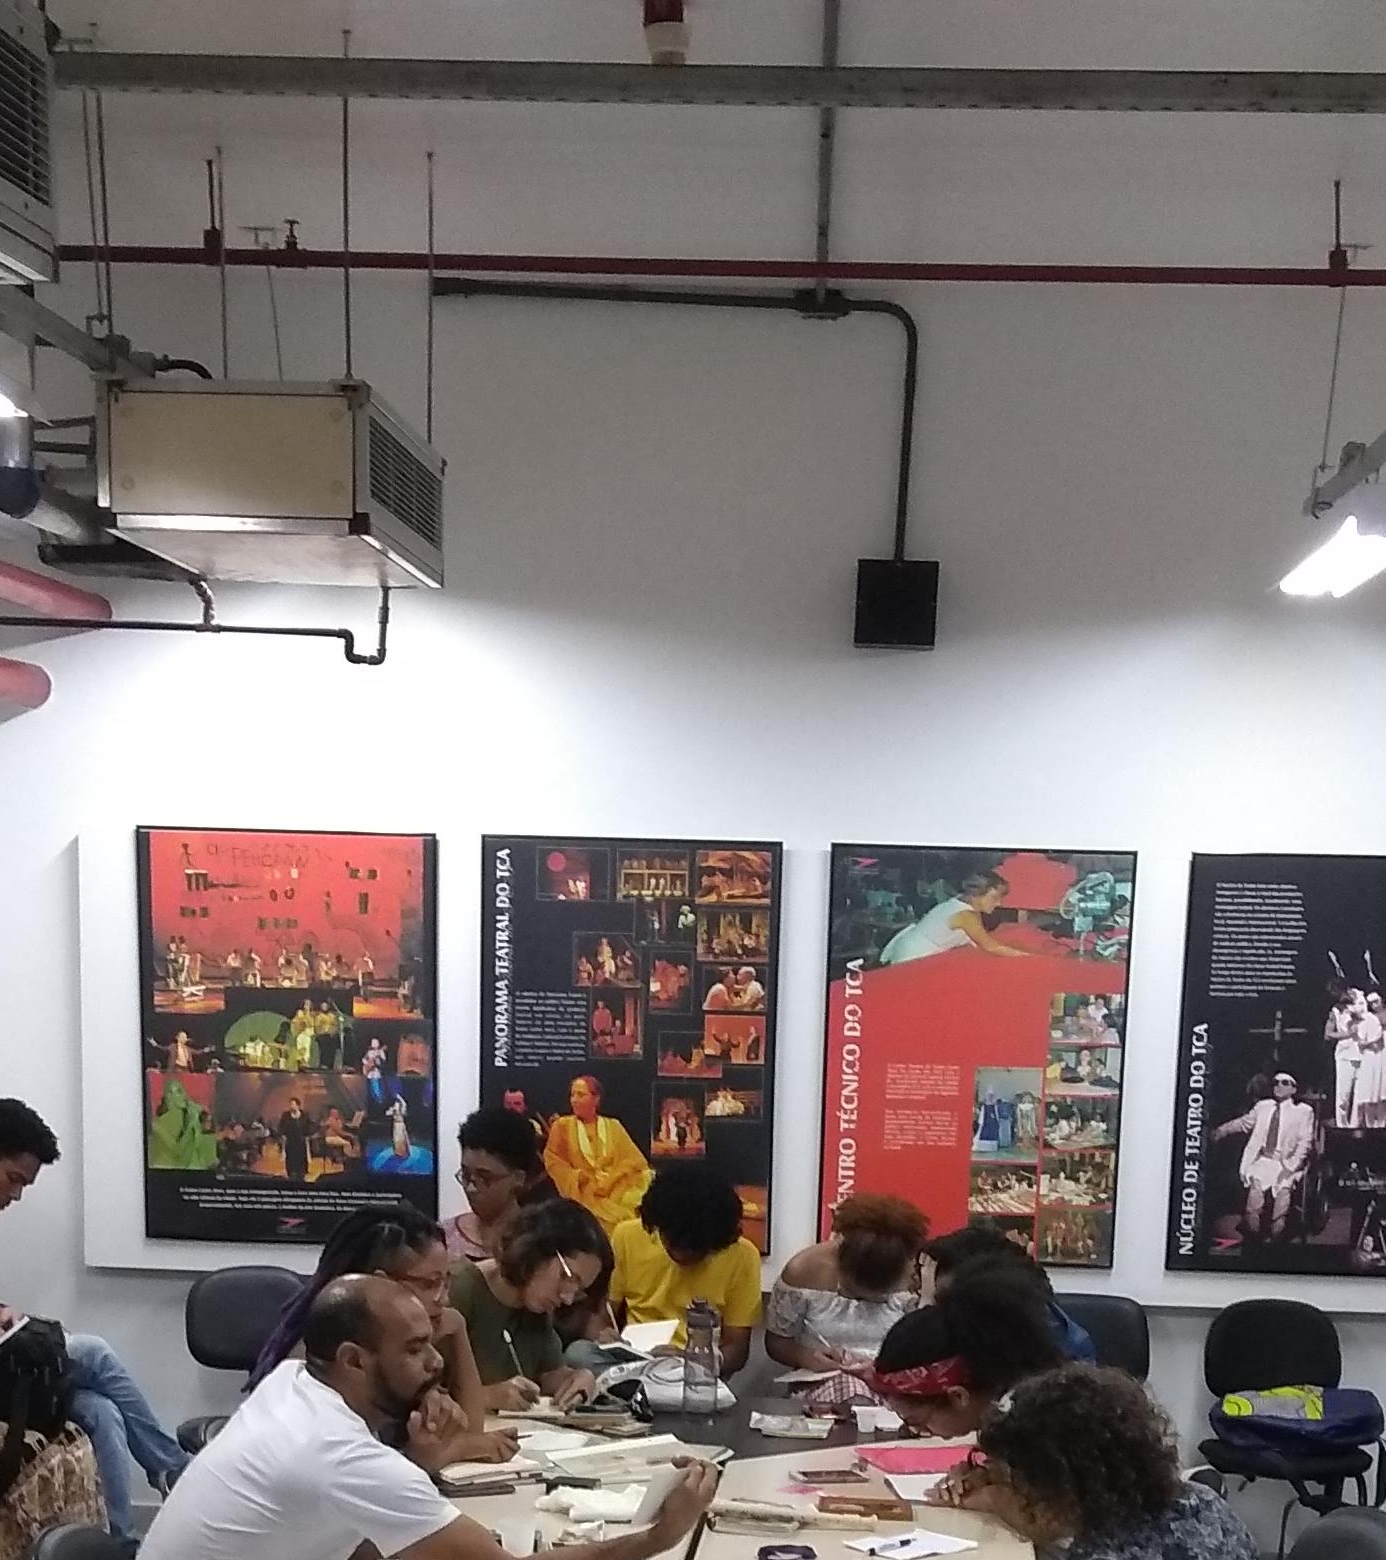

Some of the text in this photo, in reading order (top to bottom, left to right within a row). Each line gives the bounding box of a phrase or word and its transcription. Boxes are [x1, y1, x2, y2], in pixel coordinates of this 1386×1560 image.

[494, 848, 511, 1067] PANORAMA TEATRAL DO TCA
[836, 958, 864, 1207] ENTRO TÉCNICO DO TCA
[1174, 1023, 1209, 1255] NÚCLEO DE TEATRO DO TCA
